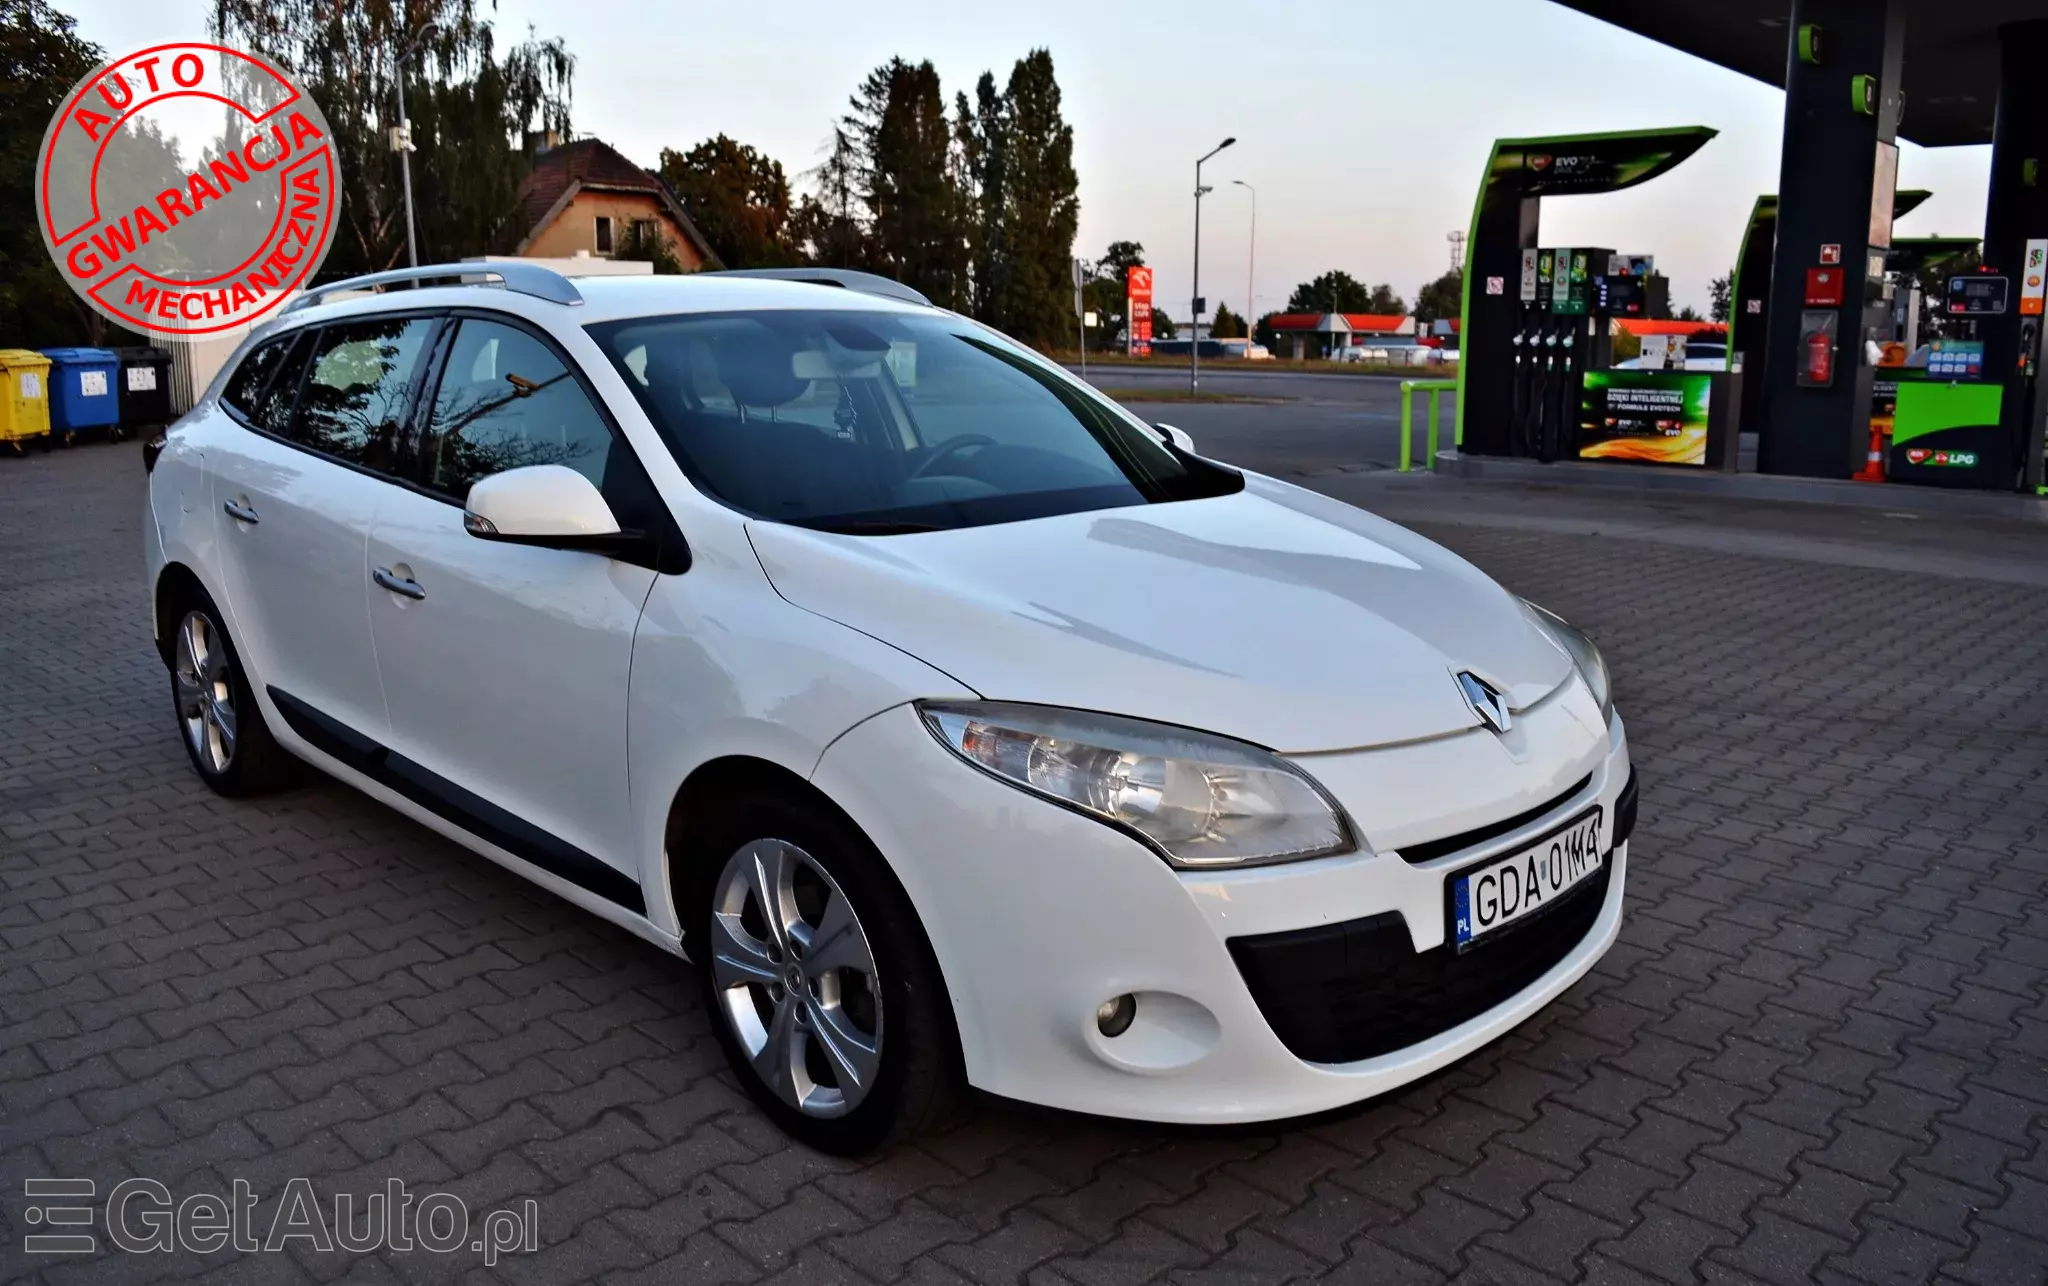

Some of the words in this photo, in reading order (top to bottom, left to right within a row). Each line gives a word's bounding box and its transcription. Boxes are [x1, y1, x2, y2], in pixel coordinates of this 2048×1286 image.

[1556, 156, 1578, 166] EVO
[1949, 454, 1974, 464] LPG
[1476, 855, 1541, 926] GDA
[1550, 818, 1598, 890] 01M4
[1457, 917, 1470, 935] PL
